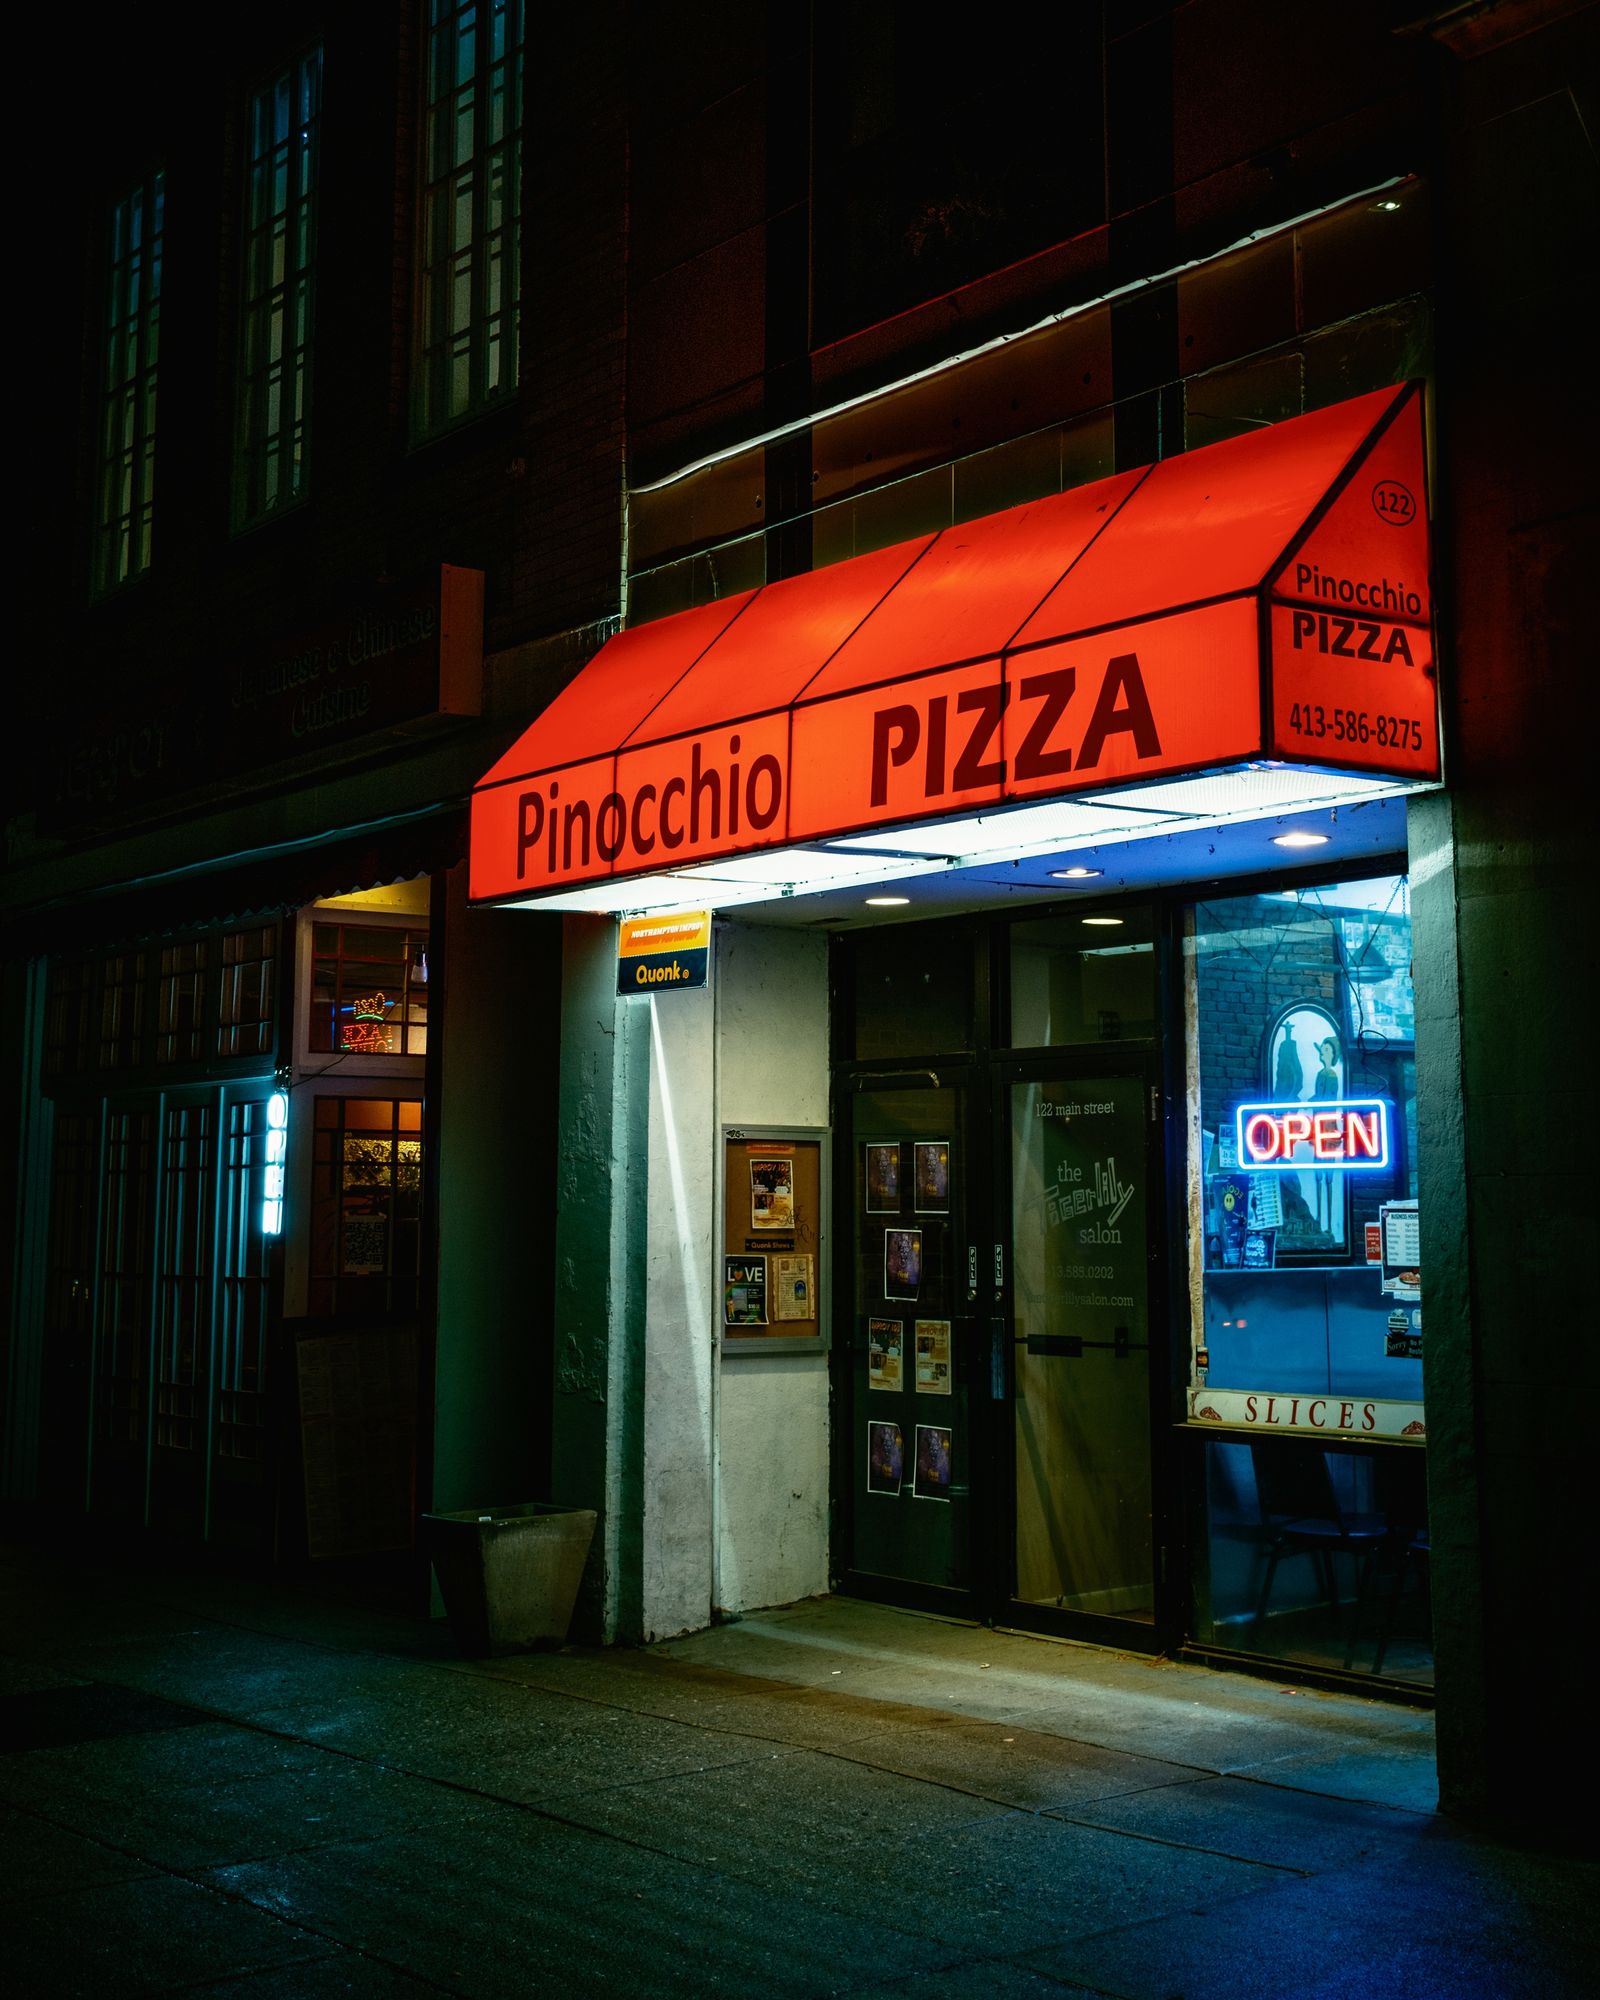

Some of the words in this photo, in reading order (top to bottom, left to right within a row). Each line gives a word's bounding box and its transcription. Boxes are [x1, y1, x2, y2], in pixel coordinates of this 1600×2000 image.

[1378, 490, 1411, 516] 122
[1296, 563, 1422, 616] Pinocchio
[1292, 610, 1415, 667] PIZZA
[1289, 702, 1424, 751] 413-586-8275
[516, 734, 783, 880] Pinocchio
[870, 652, 1163, 808] PIZZA
[636, 960, 680, 984] Quonk
[1036, 1103, 1053, 1117] 122
[1056, 1102, 1081, 1116] main
[1084, 1101, 1115, 1115] street
[1246, 1111, 1379, 1160] OPEN
[1057, 1160, 1082, 1182] the
[1079, 1222, 1122, 1244] salon
[1244, 1396, 1376, 1431] SLICES
